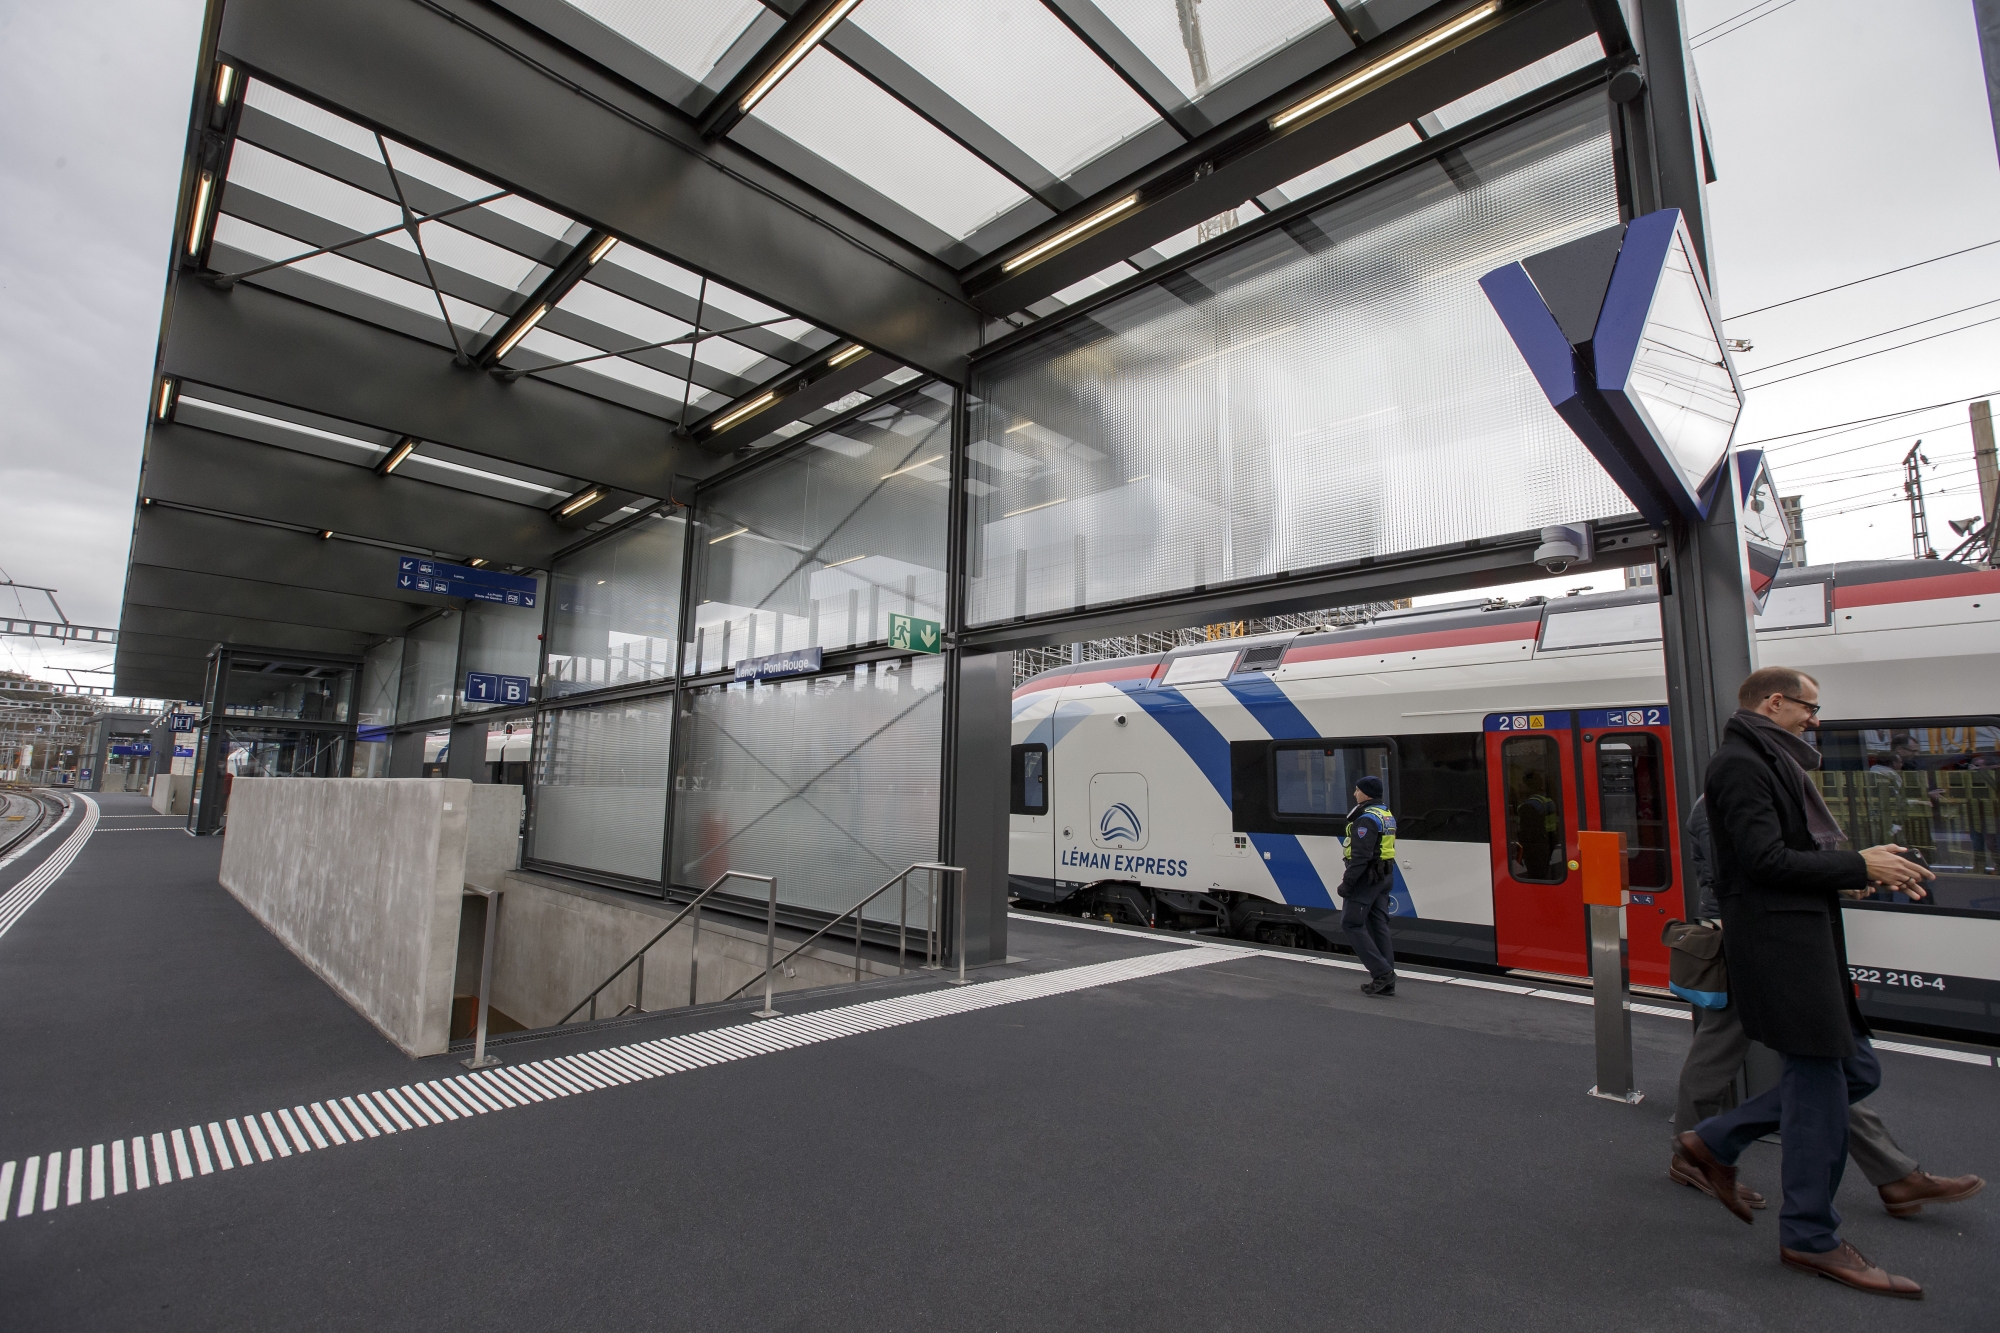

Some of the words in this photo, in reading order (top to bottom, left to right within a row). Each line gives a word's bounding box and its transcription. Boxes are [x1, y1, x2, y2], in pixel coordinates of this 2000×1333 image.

[736, 666, 757, 678] Lancy
[763, 662, 780, 674] Pont
[782, 659, 809, 671] Rouge
[478, 683, 486, 697] 1
[507, 685, 520, 700] B
[1499, 716, 1510, 730] 2
[1648, 709, 1660, 725] 2
[1062, 847, 1111, 869] LÉMAN
[1114, 855, 1188, 877] EXPRESS
[1848, 968, 1881, 983] 522
[1886, 972, 1946, 991] 216-4
